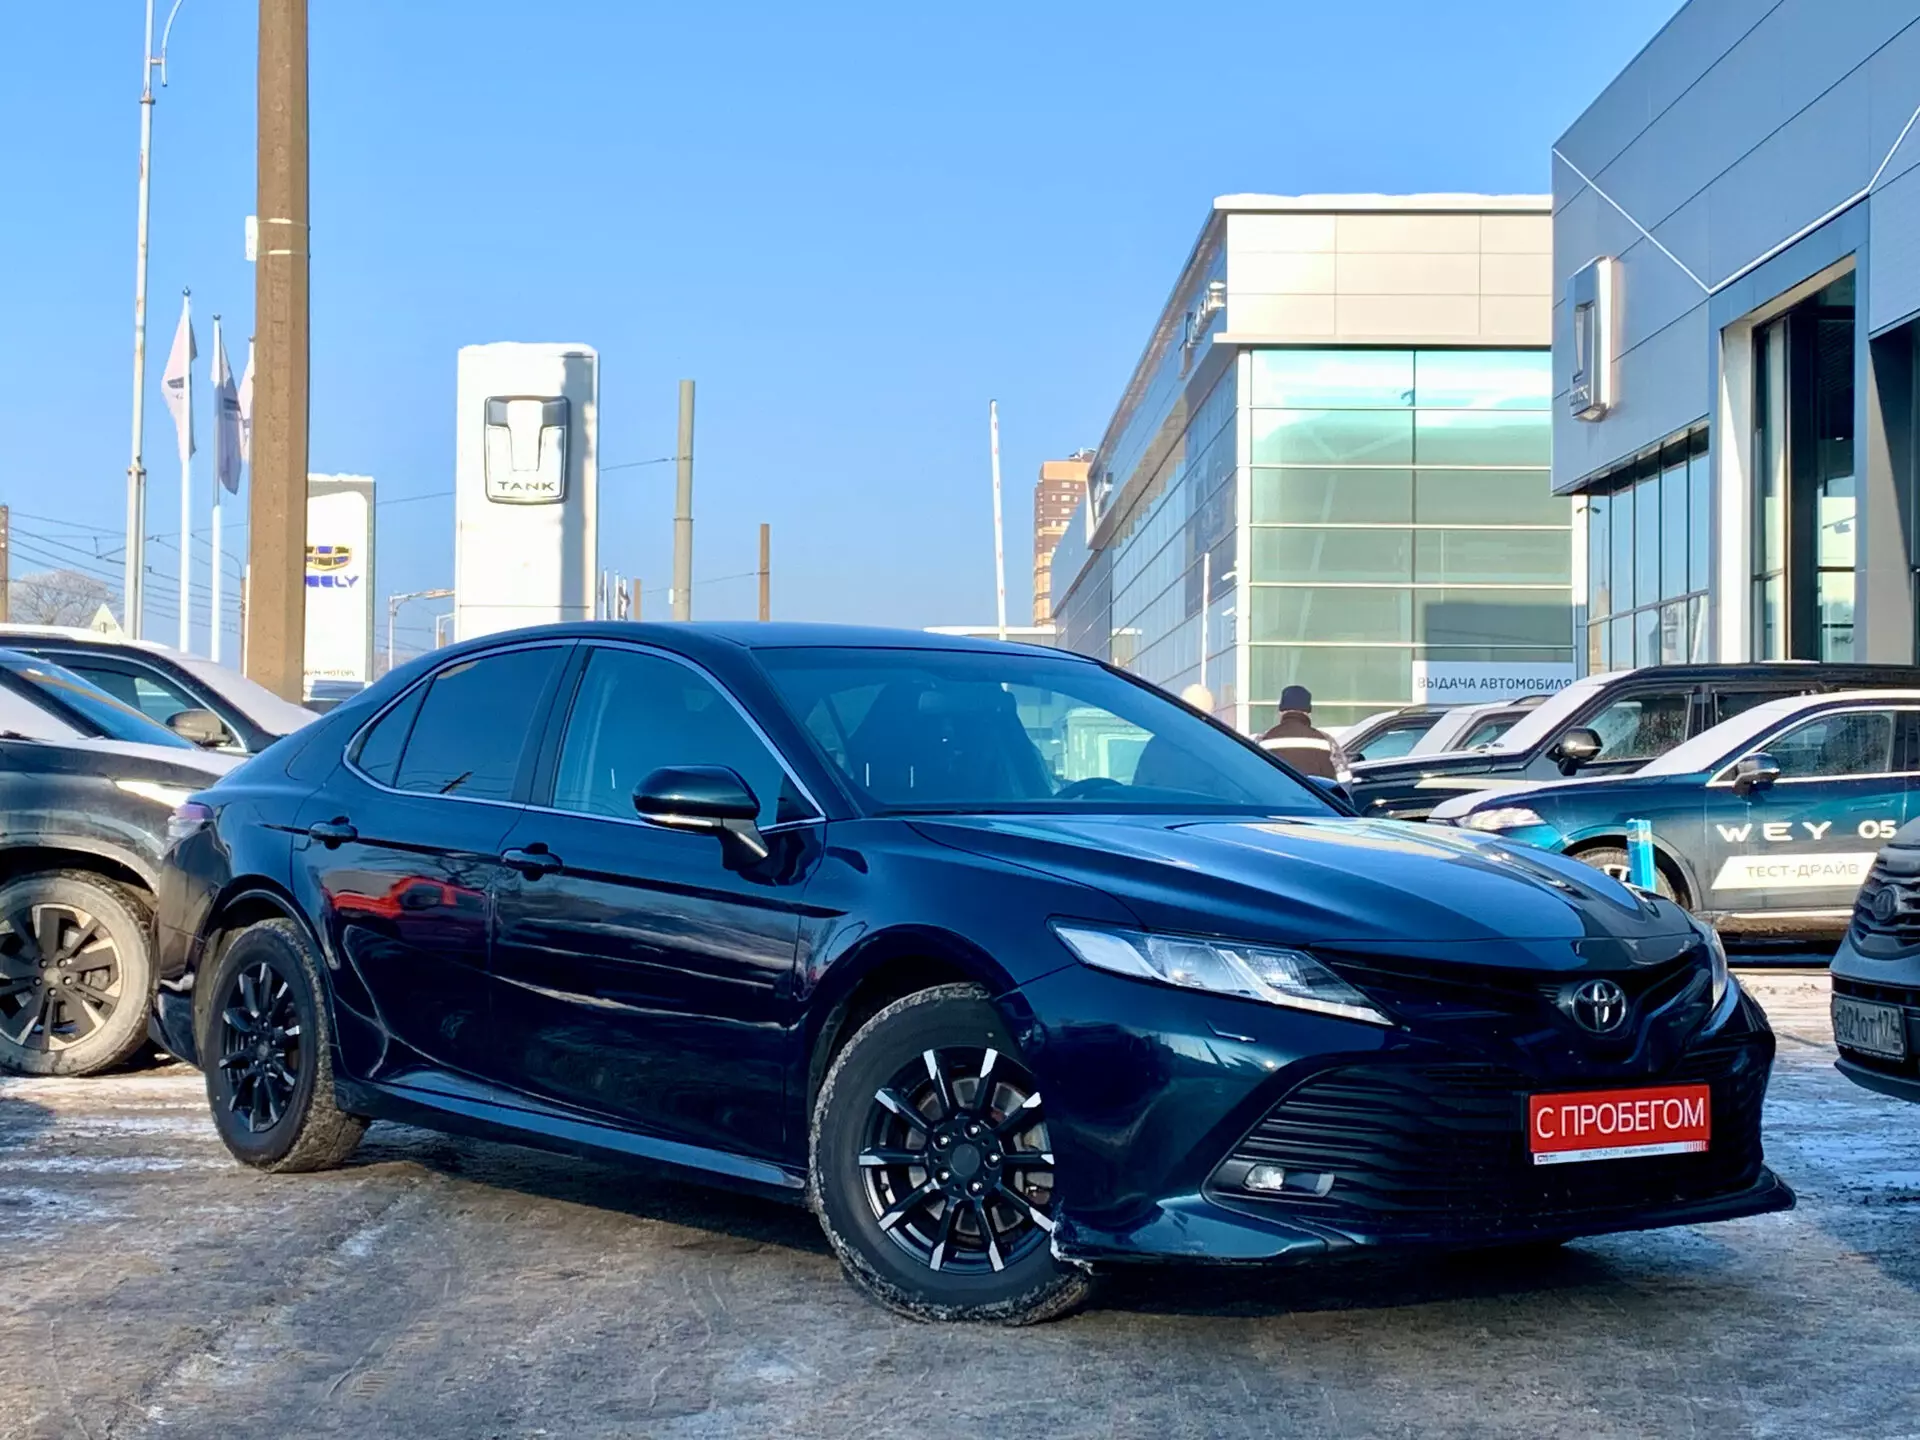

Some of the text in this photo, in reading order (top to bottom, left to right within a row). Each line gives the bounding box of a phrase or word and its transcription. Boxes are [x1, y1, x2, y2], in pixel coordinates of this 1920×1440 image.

[497, 481, 555, 491] TANK
[305, 575, 360, 588] EELY
[1418, 677, 1477, 690] ВЫДАЧА
[1716, 819, 1898, 843] WEY 05
[1746, 861, 1860, 879] ТЕСТ-ДРАЙВ
[1536, 1097, 1705, 1139] С ПРОБЕГОМ
